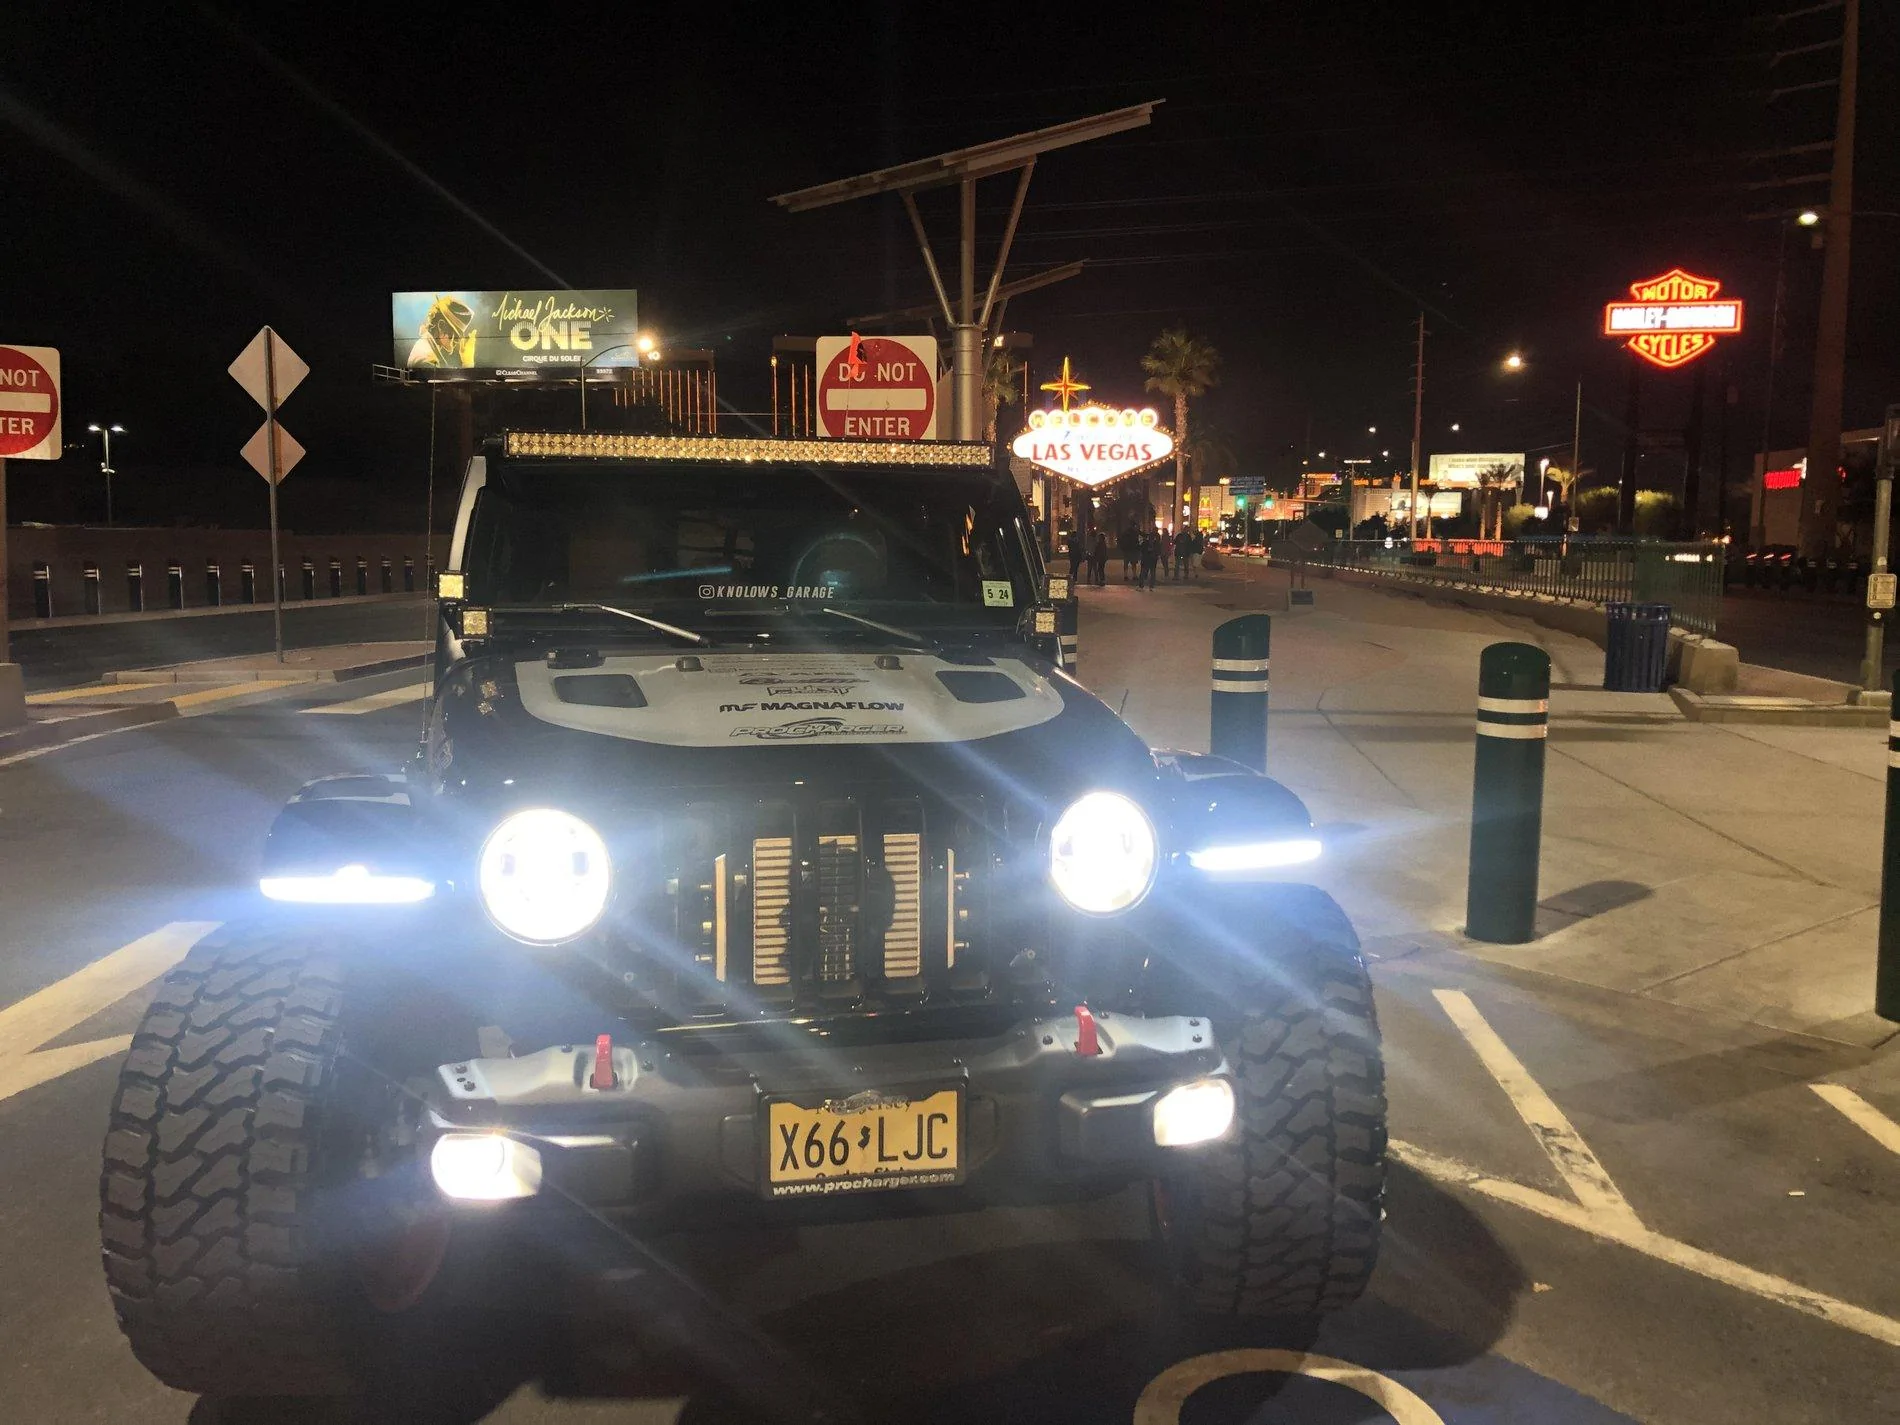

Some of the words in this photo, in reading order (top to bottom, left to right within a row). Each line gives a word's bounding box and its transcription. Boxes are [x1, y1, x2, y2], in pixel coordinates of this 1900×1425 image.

[1641, 276, 1708, 301] MOTOR
[492, 293, 541, 330] Michael
[538, 296, 600, 330] Jackson
[510, 321, 593, 350] ONE
[1638, 334, 1704, 361] CYCLES
[522, 355, 548, 363] CIRQUE
[0, 369, 40, 387] NOT
[877, 363, 917, 381] NOT
[845, 417, 910, 436] ENTER
[1032, 443, 1072, 461] LAS
[1080, 443, 1152, 461] VEGAS
[987, 588, 994, 599] 5
[998, 589, 1009, 600] 24
[760, 702, 905, 711] MAGNAFLOW
[729, 722, 905, 737] PROCHARGER
[779, 1120, 849, 1171] X66
[878, 1113, 948, 1162] LJC
[773, 1173, 955, 1195] www.procharger.com
